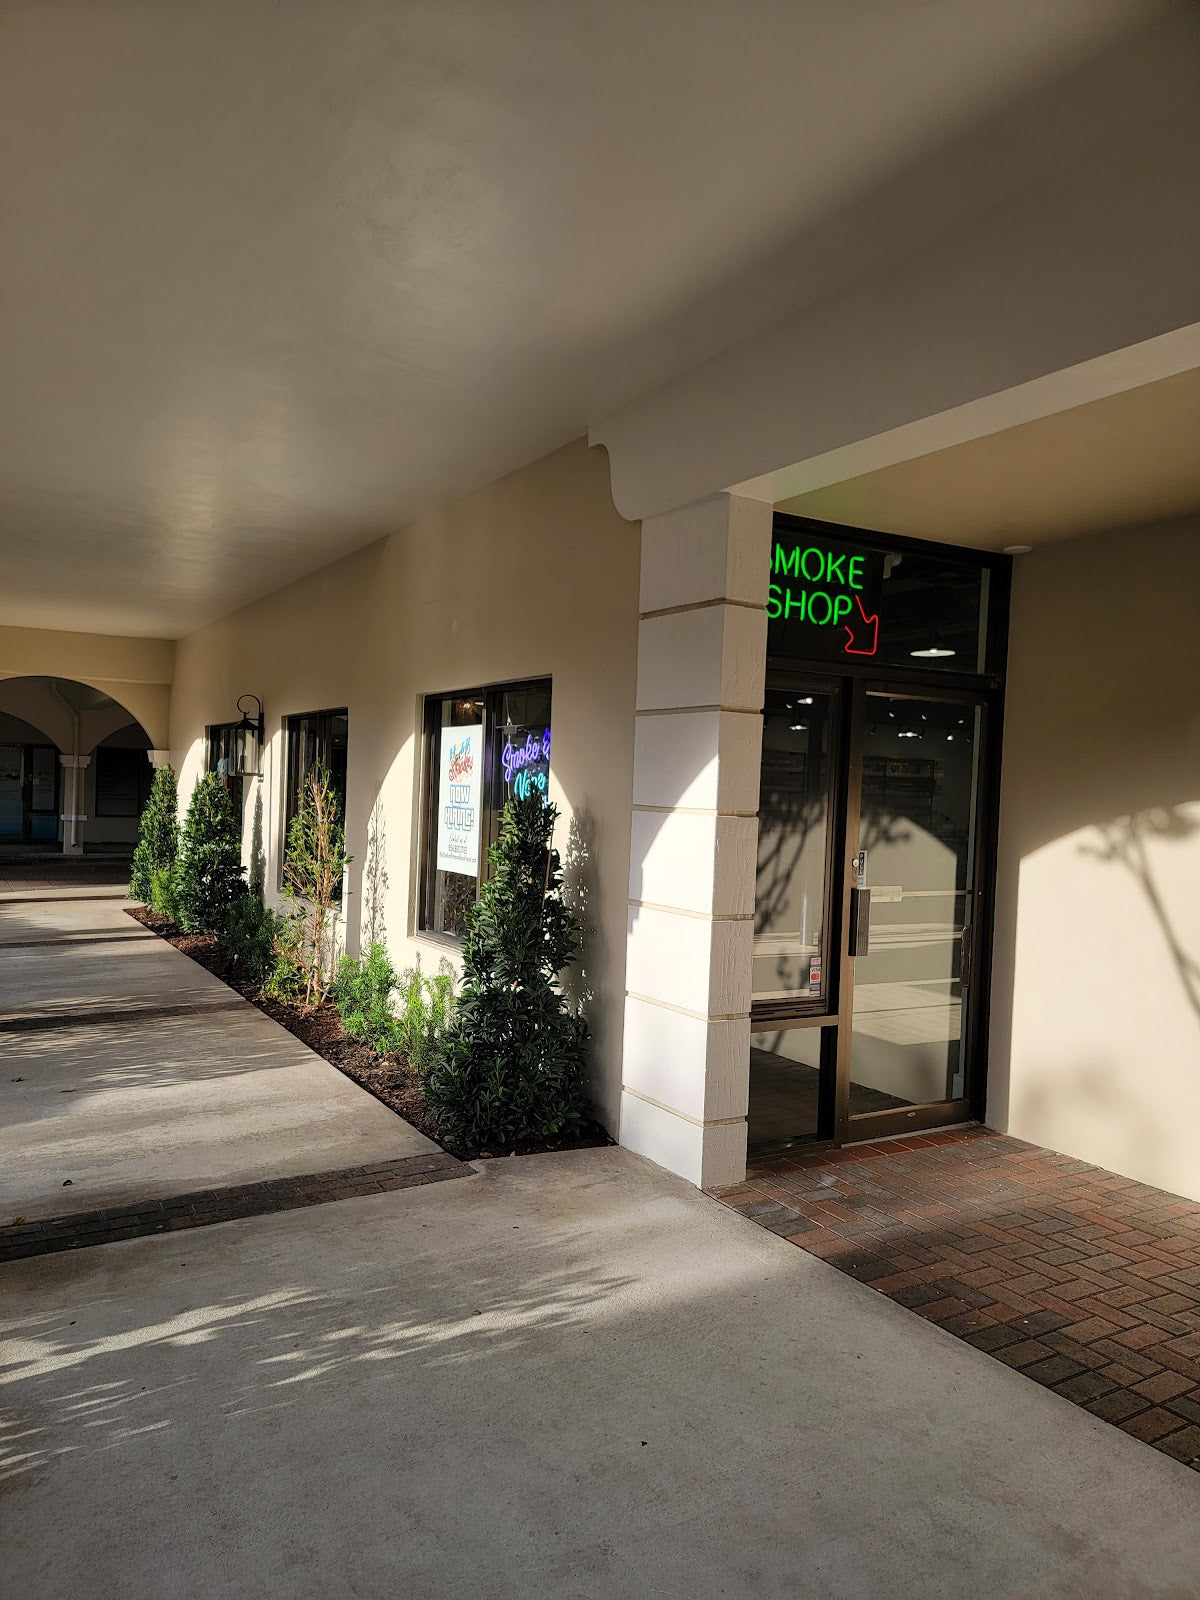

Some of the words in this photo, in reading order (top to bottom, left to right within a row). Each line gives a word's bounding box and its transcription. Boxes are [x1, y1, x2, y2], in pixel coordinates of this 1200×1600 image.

[770, 543, 865, 590] MOKE
[766, 583, 853, 625] SHOP
[502, 734, 539, 782] Smoke
